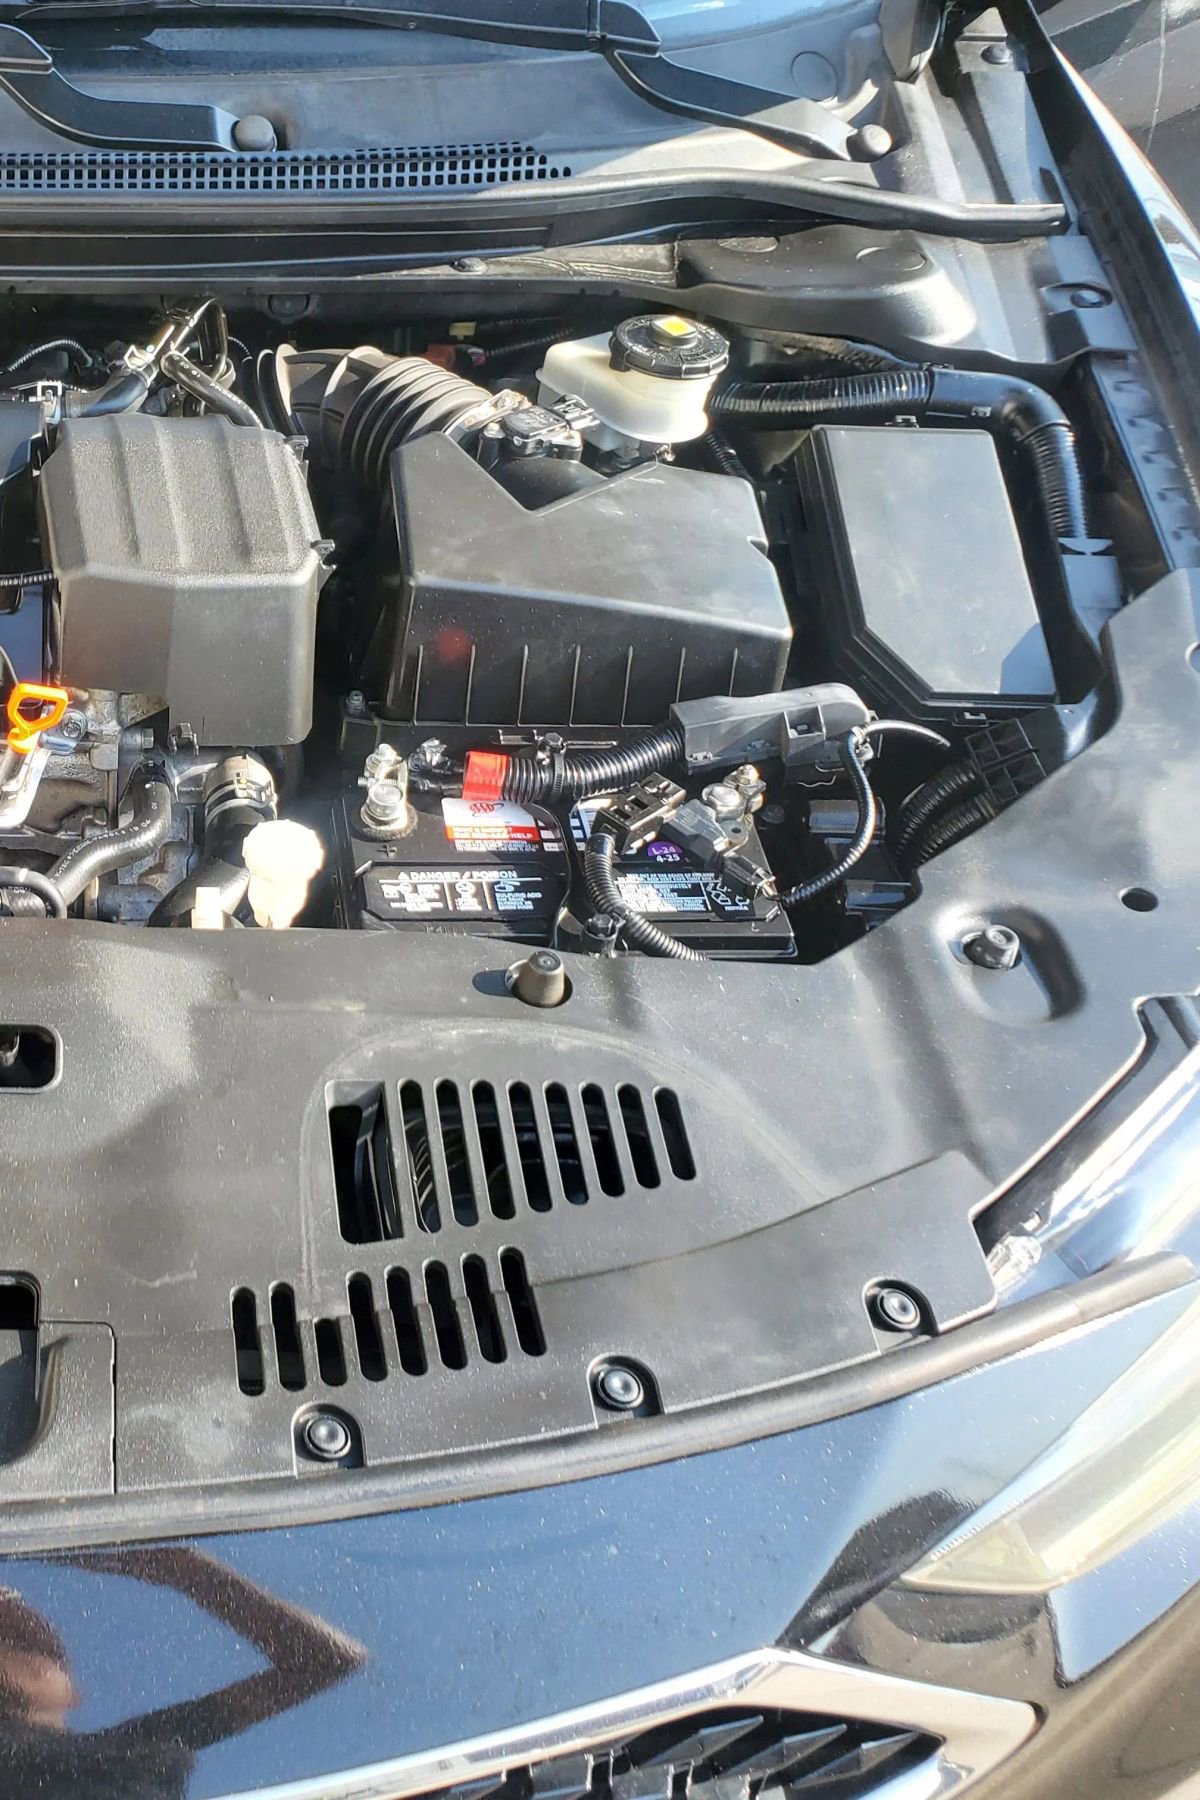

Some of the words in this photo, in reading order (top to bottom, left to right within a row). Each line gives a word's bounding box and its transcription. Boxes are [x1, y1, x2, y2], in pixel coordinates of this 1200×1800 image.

[652, 847, 676, 855] L-24
[656, 854, 680, 862] 4-25
[411, 872, 461, 880] DANGER
[472, 870, 518, 880] POISON
